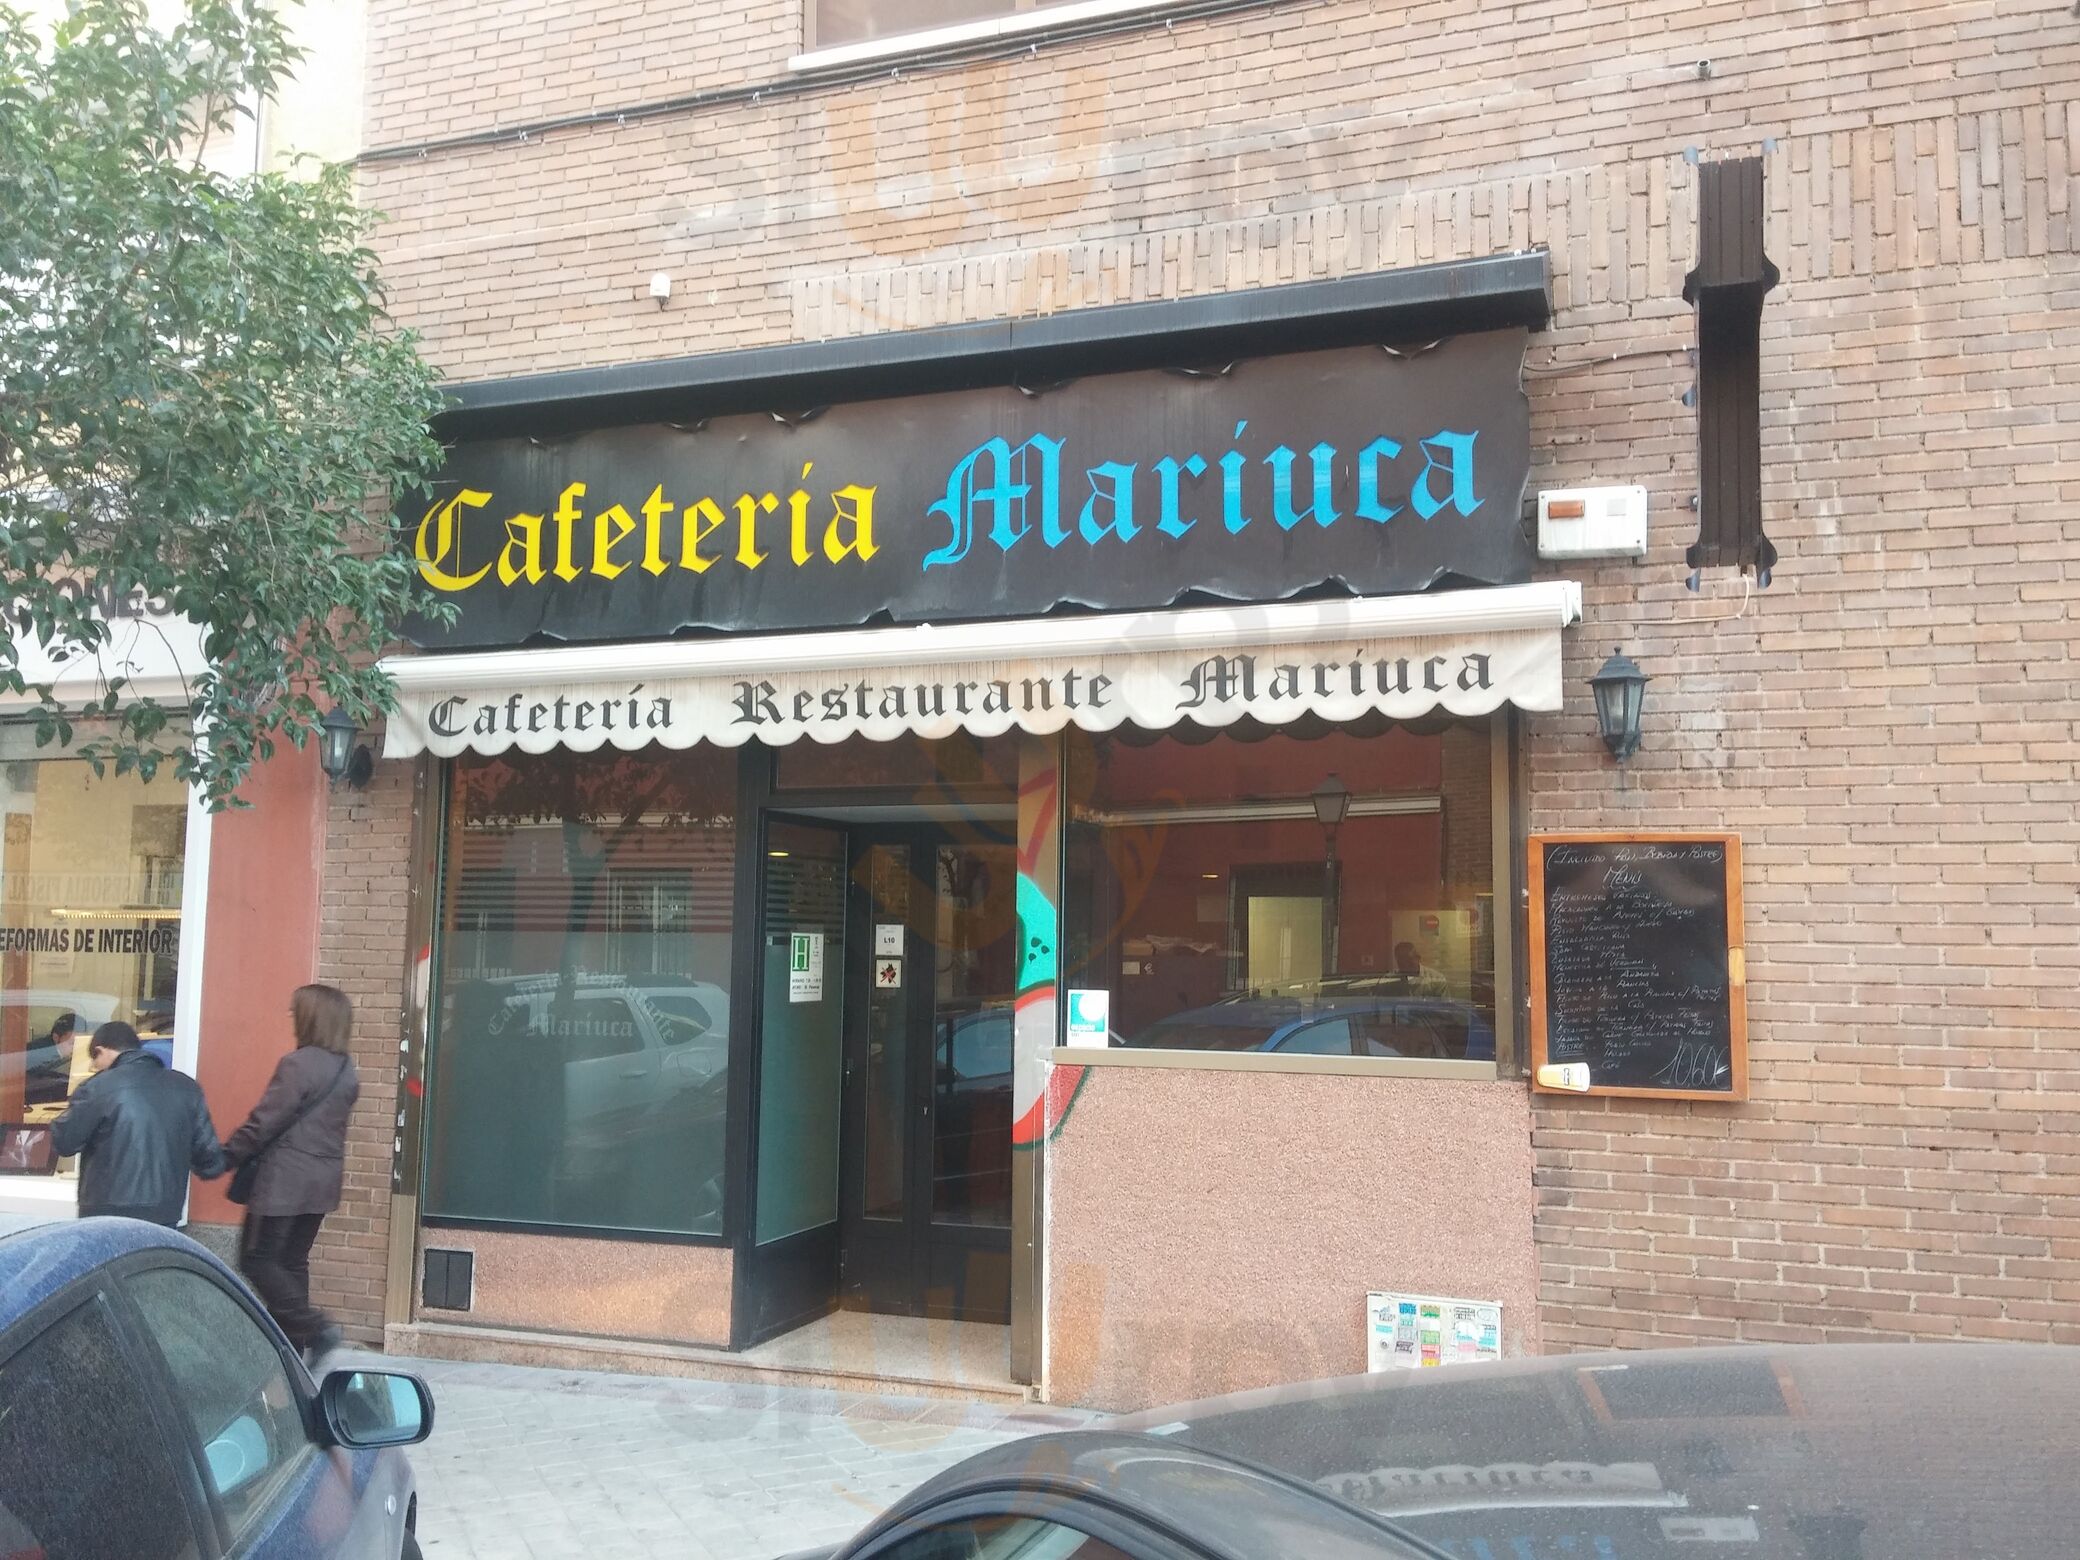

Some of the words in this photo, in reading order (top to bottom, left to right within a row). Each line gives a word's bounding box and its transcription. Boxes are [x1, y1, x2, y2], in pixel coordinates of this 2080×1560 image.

[428, 683, 673, 737] Cafetería
[731, 667, 1112, 725] Restaurante
[73, 928, 95, 952] DE
[98, 928, 173, 954] INTERIOR
[793, 937, 809, 970] H
